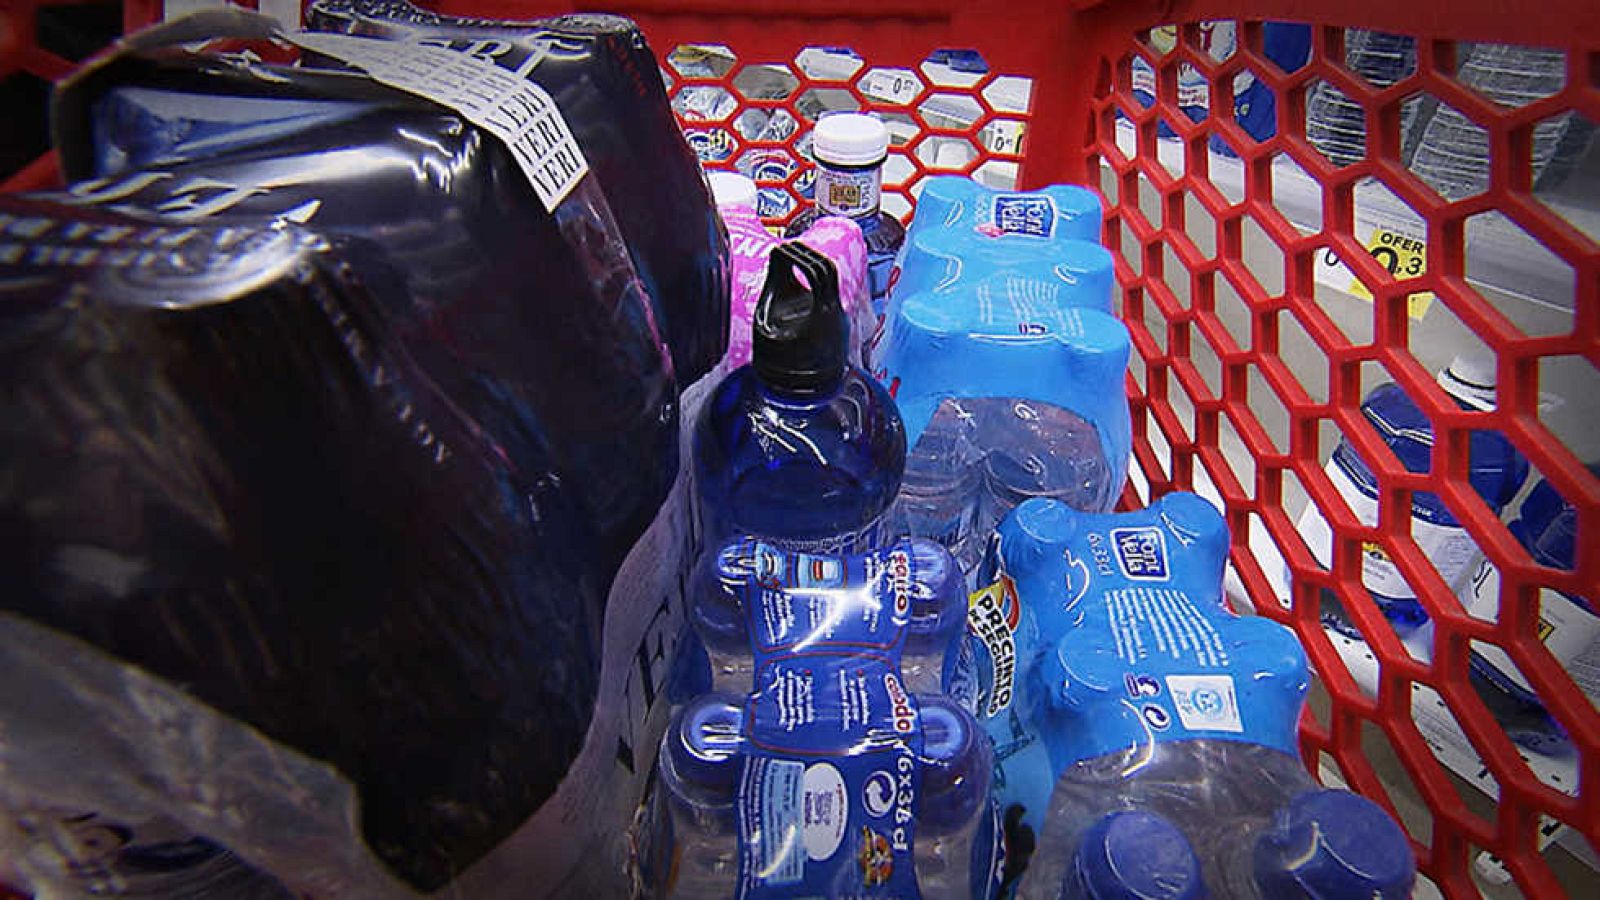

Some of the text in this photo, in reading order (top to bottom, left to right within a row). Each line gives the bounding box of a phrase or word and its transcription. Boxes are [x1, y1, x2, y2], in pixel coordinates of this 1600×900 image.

[513, 112, 564, 166] VERI
[532, 143, 580, 197] VERI
[1120, 534, 1144, 573] Vella
[1139, 532, 1160, 574] Font
[977, 594, 1014, 706] PRECINTO
